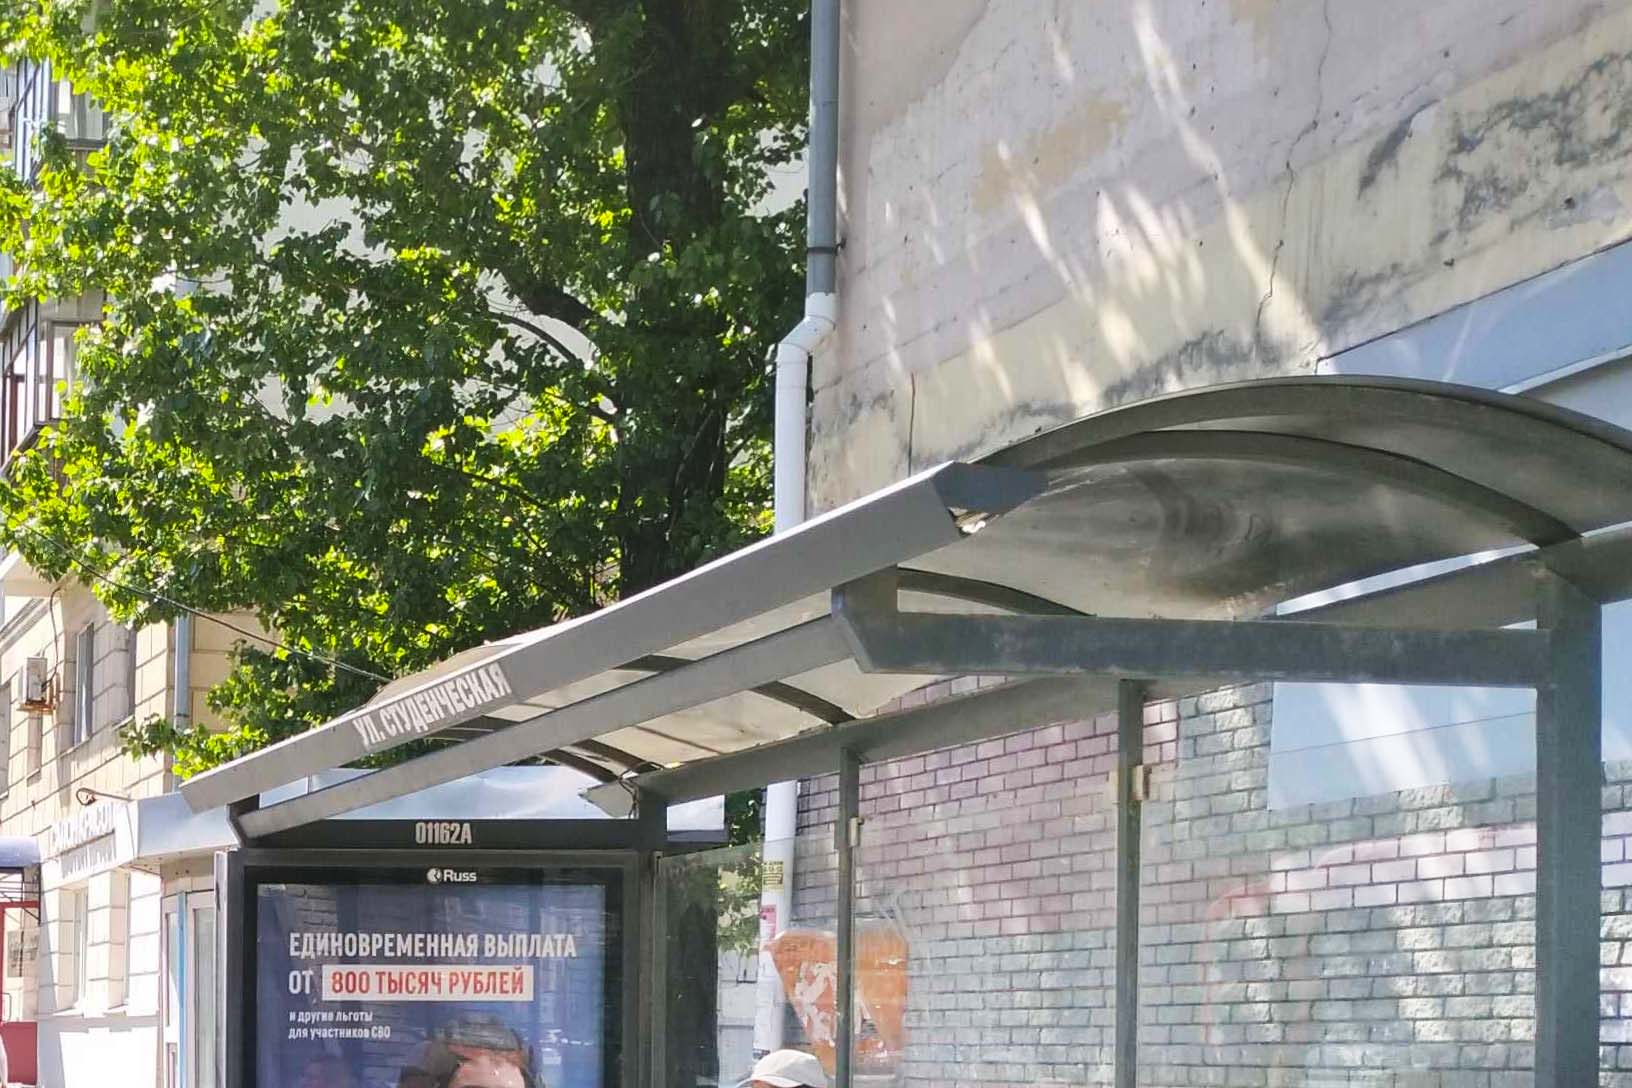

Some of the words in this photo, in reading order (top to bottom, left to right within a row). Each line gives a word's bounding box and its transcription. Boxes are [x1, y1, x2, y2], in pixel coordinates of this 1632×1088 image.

[351, 715, 386, 746] УЛ.
[379, 661, 513, 736] СТУДЕНЧЕСКАЯ
[415, 822, 472, 845] 01162A
[443, 868, 477, 882] Russ
[289, 932, 478, 961] ЕДИНОВРЕМЕННАЯ
[484, 933, 577, 959] ВЫПЛАТА
[288, 969, 313, 995] ОТ
[331, 970, 369, 995] 800
[376, 970, 442, 995] ТЫСЯЧ
[449, 966, 524, 994] РУБЛЕЙ
[289, 1011, 295, 1021] и
[297, 1011, 333, 1023] другие
[335, 1010, 373, 1021] льготы
[288, 1027, 308, 1039] для
[309, 1027, 369, 1040] участников
[370, 1025, 391, 1038] СВО
